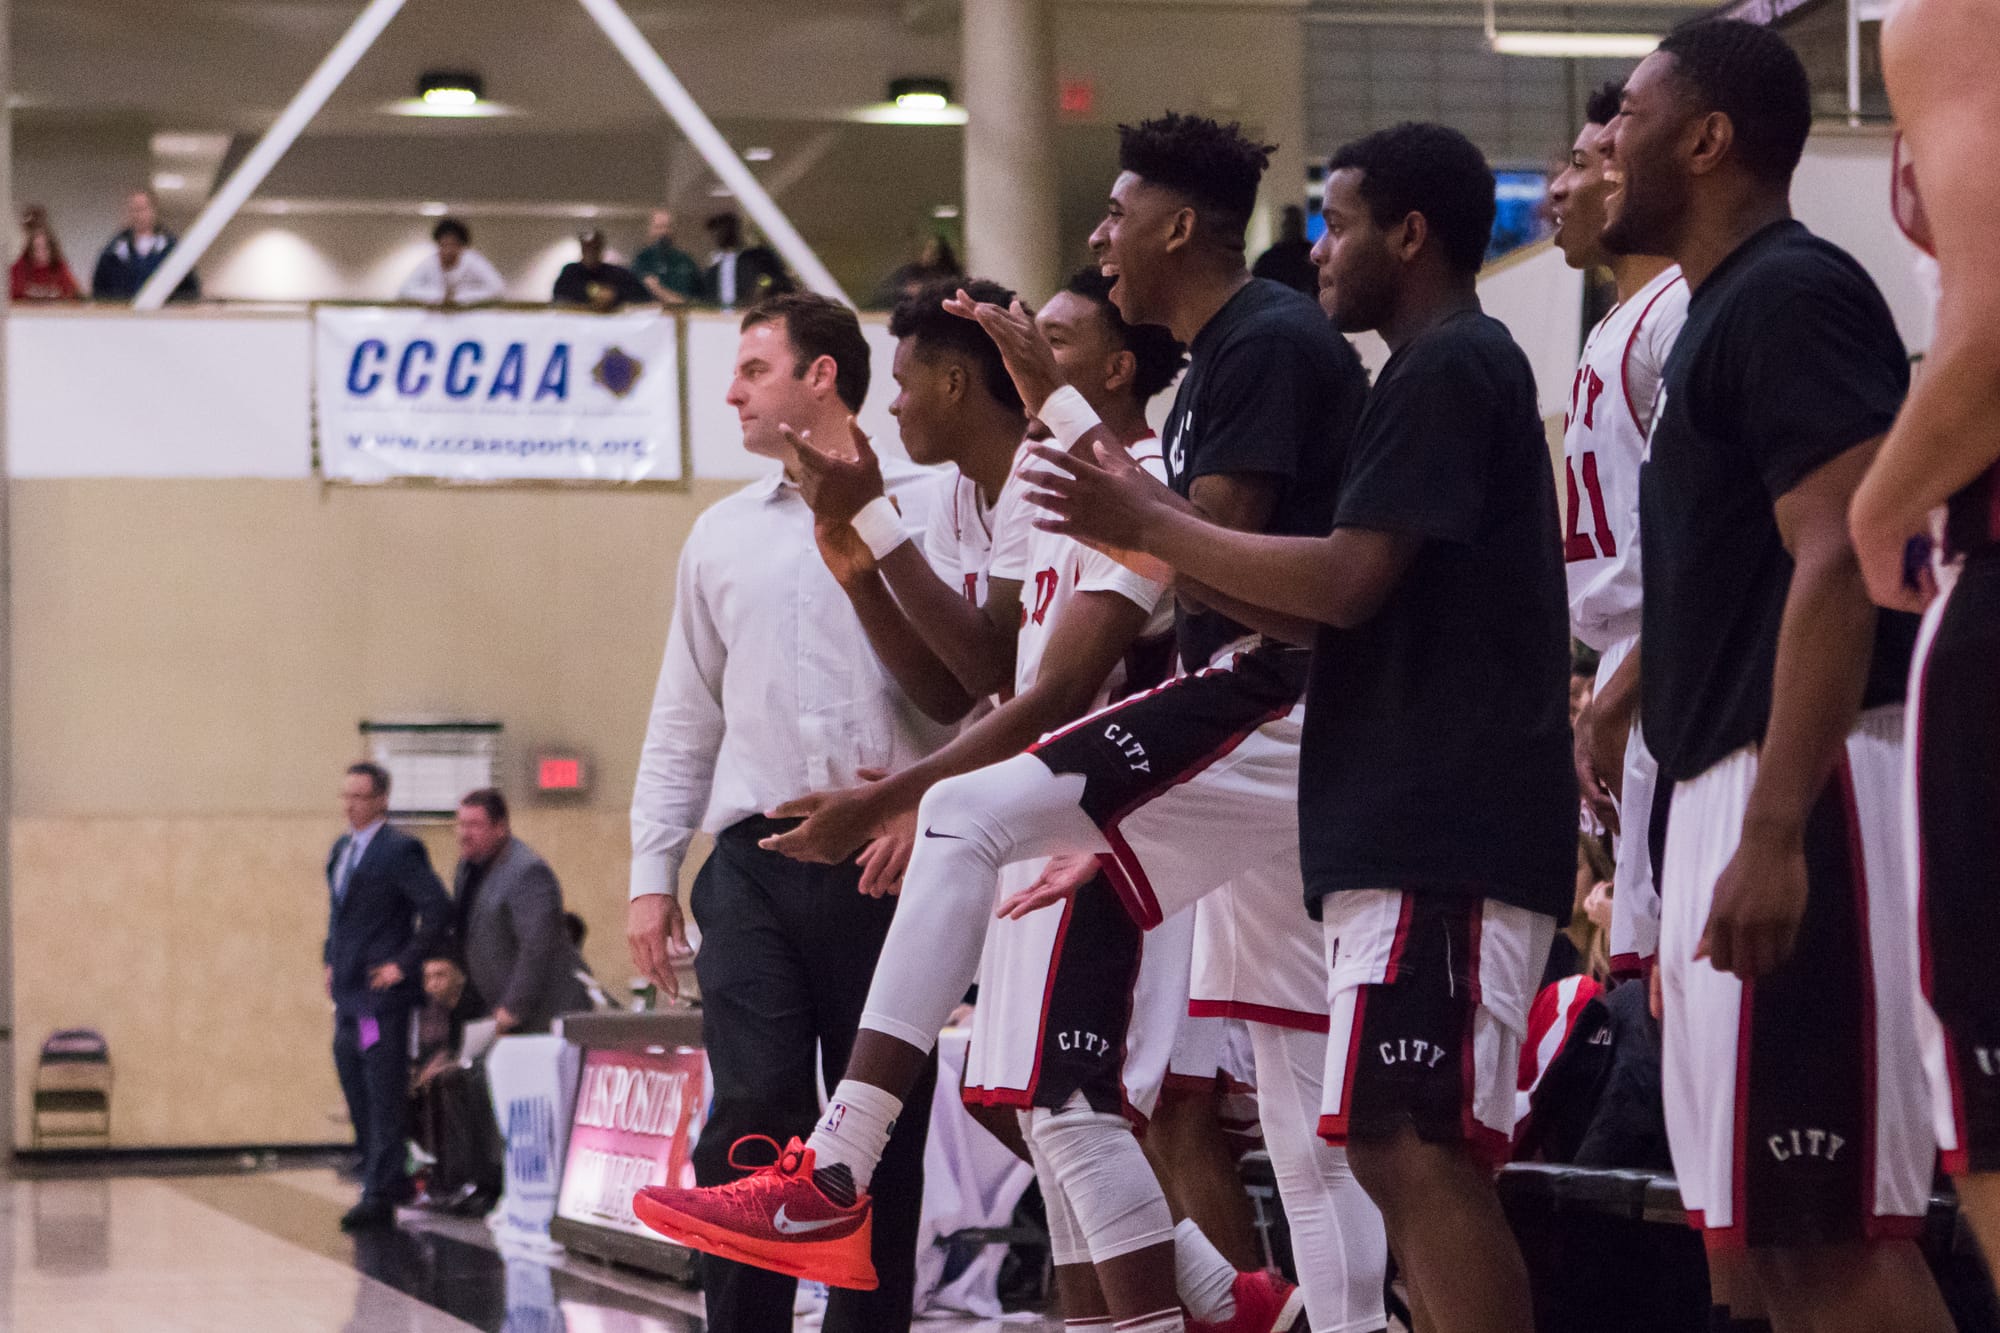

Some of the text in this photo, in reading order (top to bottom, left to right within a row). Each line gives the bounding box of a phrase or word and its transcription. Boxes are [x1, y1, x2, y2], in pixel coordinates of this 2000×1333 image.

[345, 338, 571, 400] CCCAA
[1104, 723, 1151, 775] CITY
[1058, 1030, 1110, 1057] CITY
[1379, 1039, 1446, 1068] CITY
[1767, 1128, 1846, 1162] CITY
